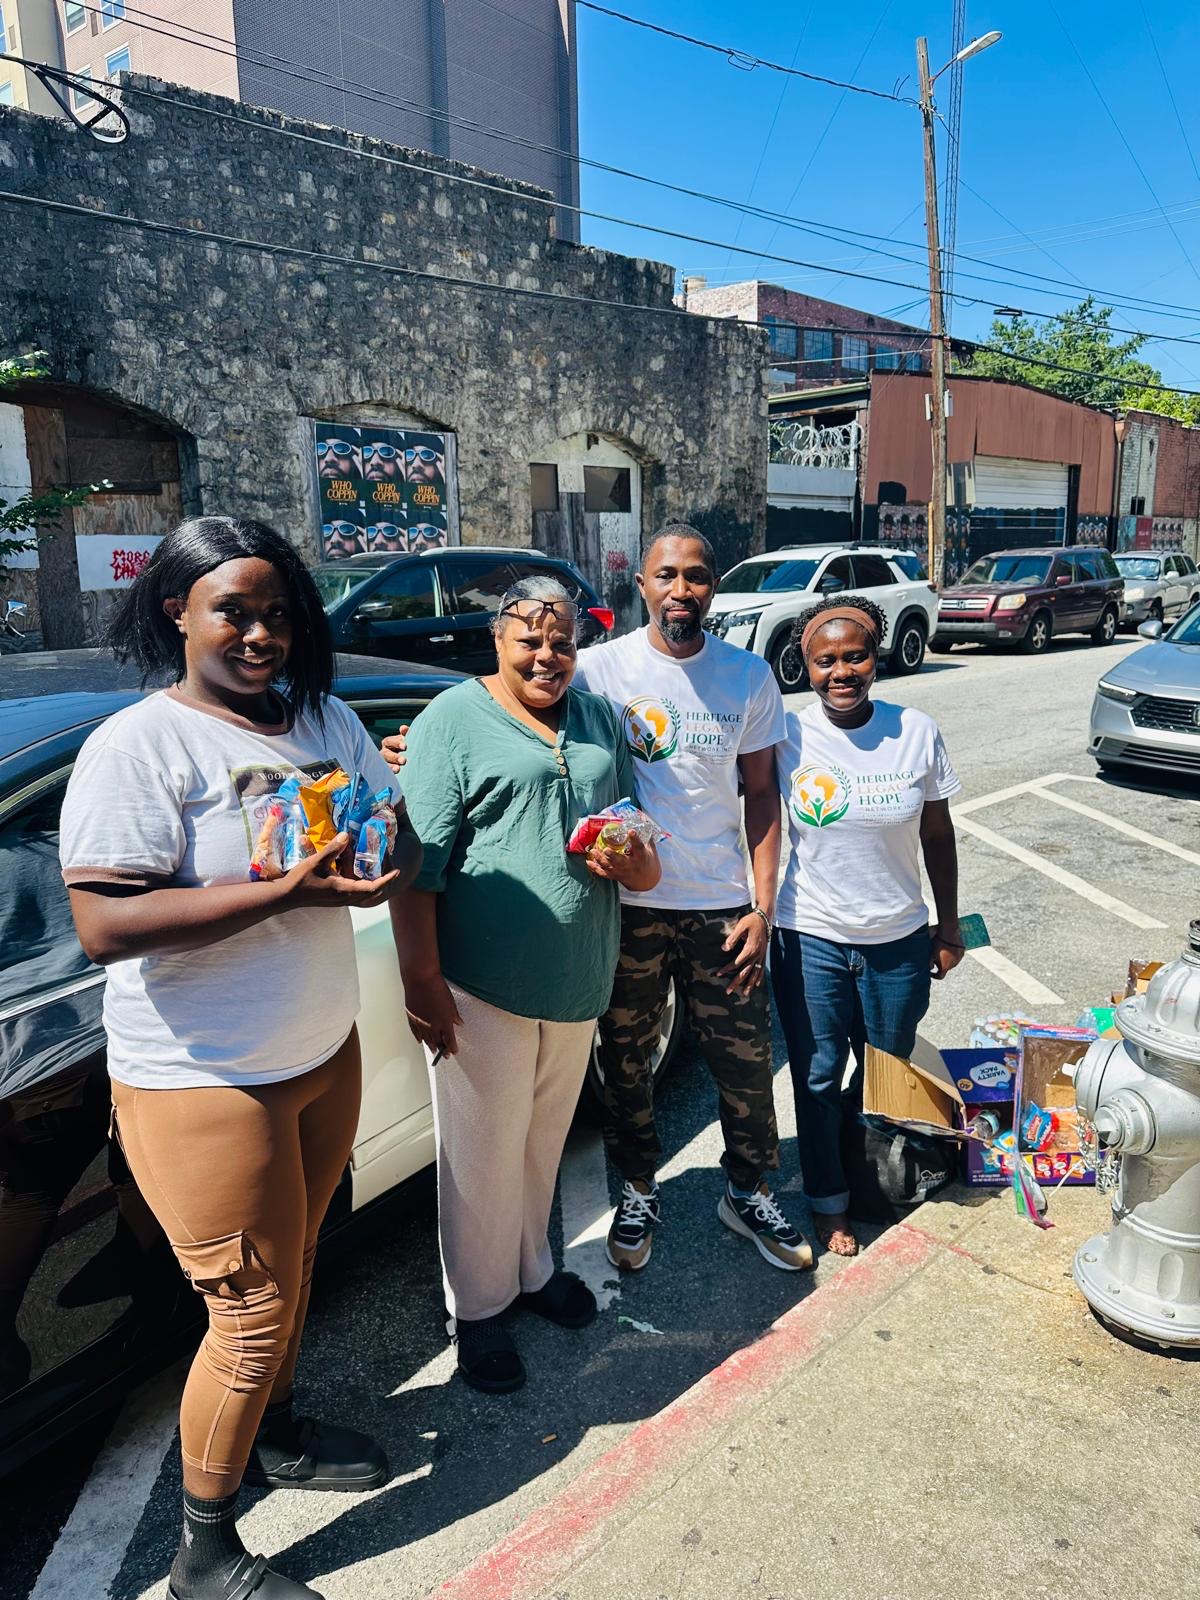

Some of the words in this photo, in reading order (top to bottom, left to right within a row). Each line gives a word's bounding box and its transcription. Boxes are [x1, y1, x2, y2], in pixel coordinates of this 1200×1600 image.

[331, 480, 352, 490] WHO
[377, 483, 396, 492] WHO
[417, 485, 436, 495] WHO
[327, 489, 357, 500] COPPIN
[372, 491, 400, 502] COPPIN
[413, 494, 440, 504] COPPIN
[686, 712, 743, 723] HERITAGE
[686, 723, 737, 733] LEGACY
[686, 733, 724, 745] HOPE
[856, 770, 917, 784] HERITAGE
[859, 793, 904, 805] HOPE
[977, 1069, 1006, 1081] VARIETY
[980, 1065, 999, 1075] PACK
